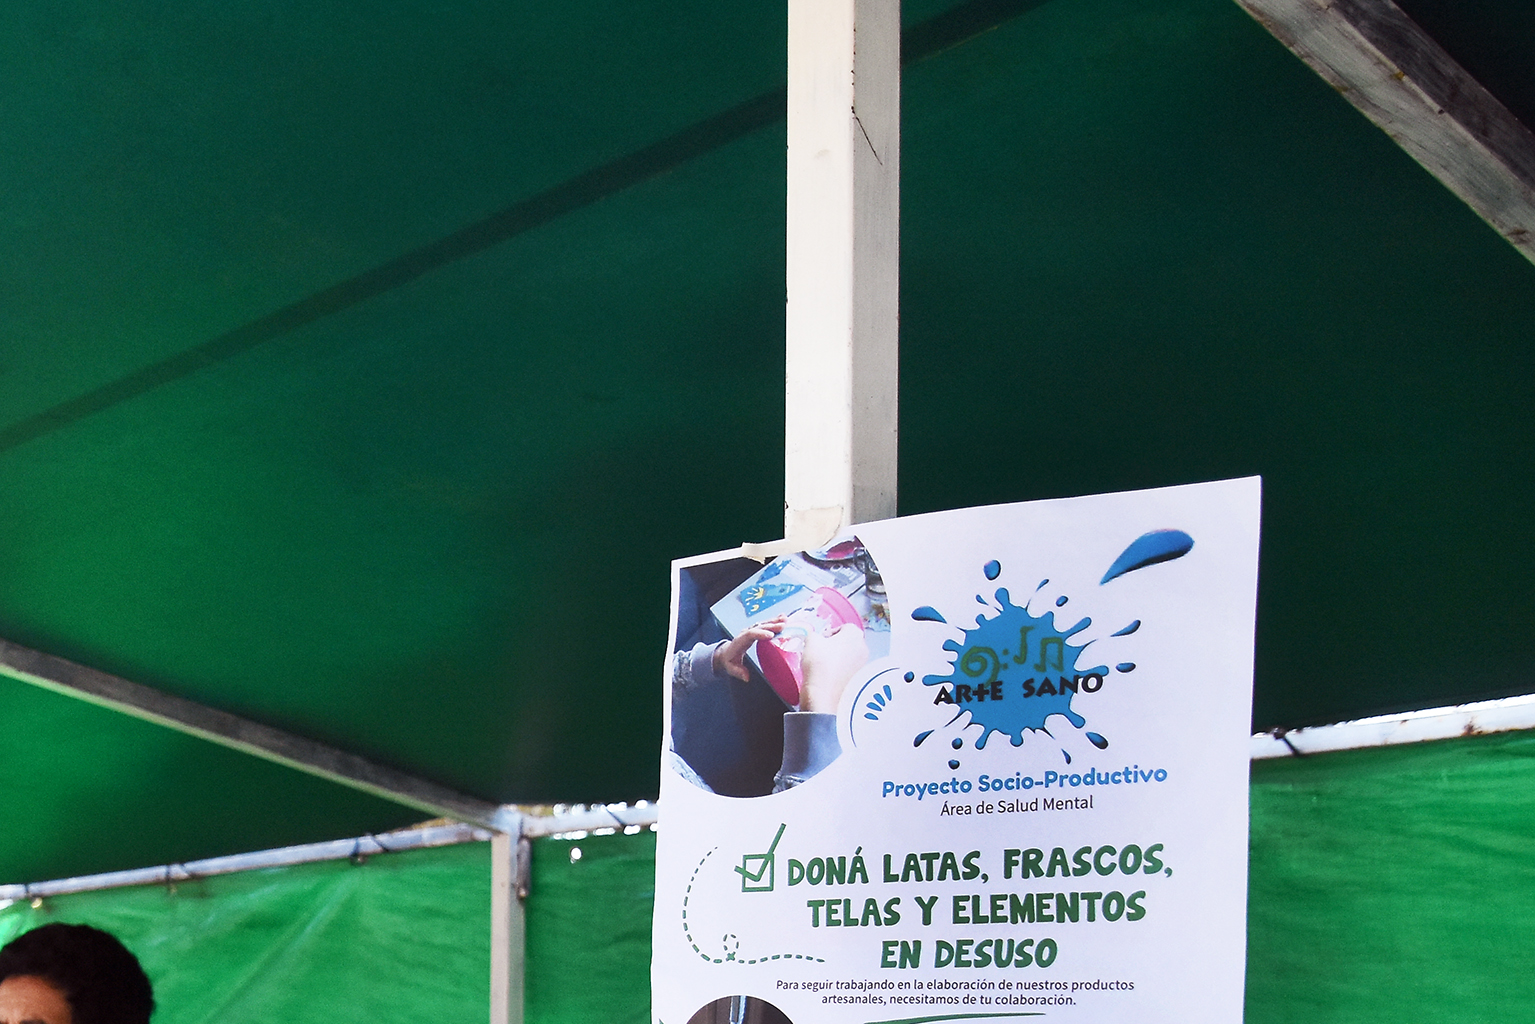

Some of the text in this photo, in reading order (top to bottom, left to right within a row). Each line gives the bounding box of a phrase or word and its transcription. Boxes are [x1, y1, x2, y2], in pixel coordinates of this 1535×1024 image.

[933, 673, 1104, 706] ARTE SANO
[882, 765, 1168, 801] Proyecto Socio-Productivo
[940, 795, 1093, 816] Área de Salud Mental
[787, 843, 1173, 887] DONÁ LATAS, FRASCOS,
[807, 890, 1146, 927] TELAS Y ELEMENTOS
[880, 938, 1059, 969] EN DESUSO
[776, 979, 1135, 992] Para seguir trabajando en la elaboración de nuestros productos
[821, 994, 1076, 1006] artesanales, necesitamos de tu colaboración.
